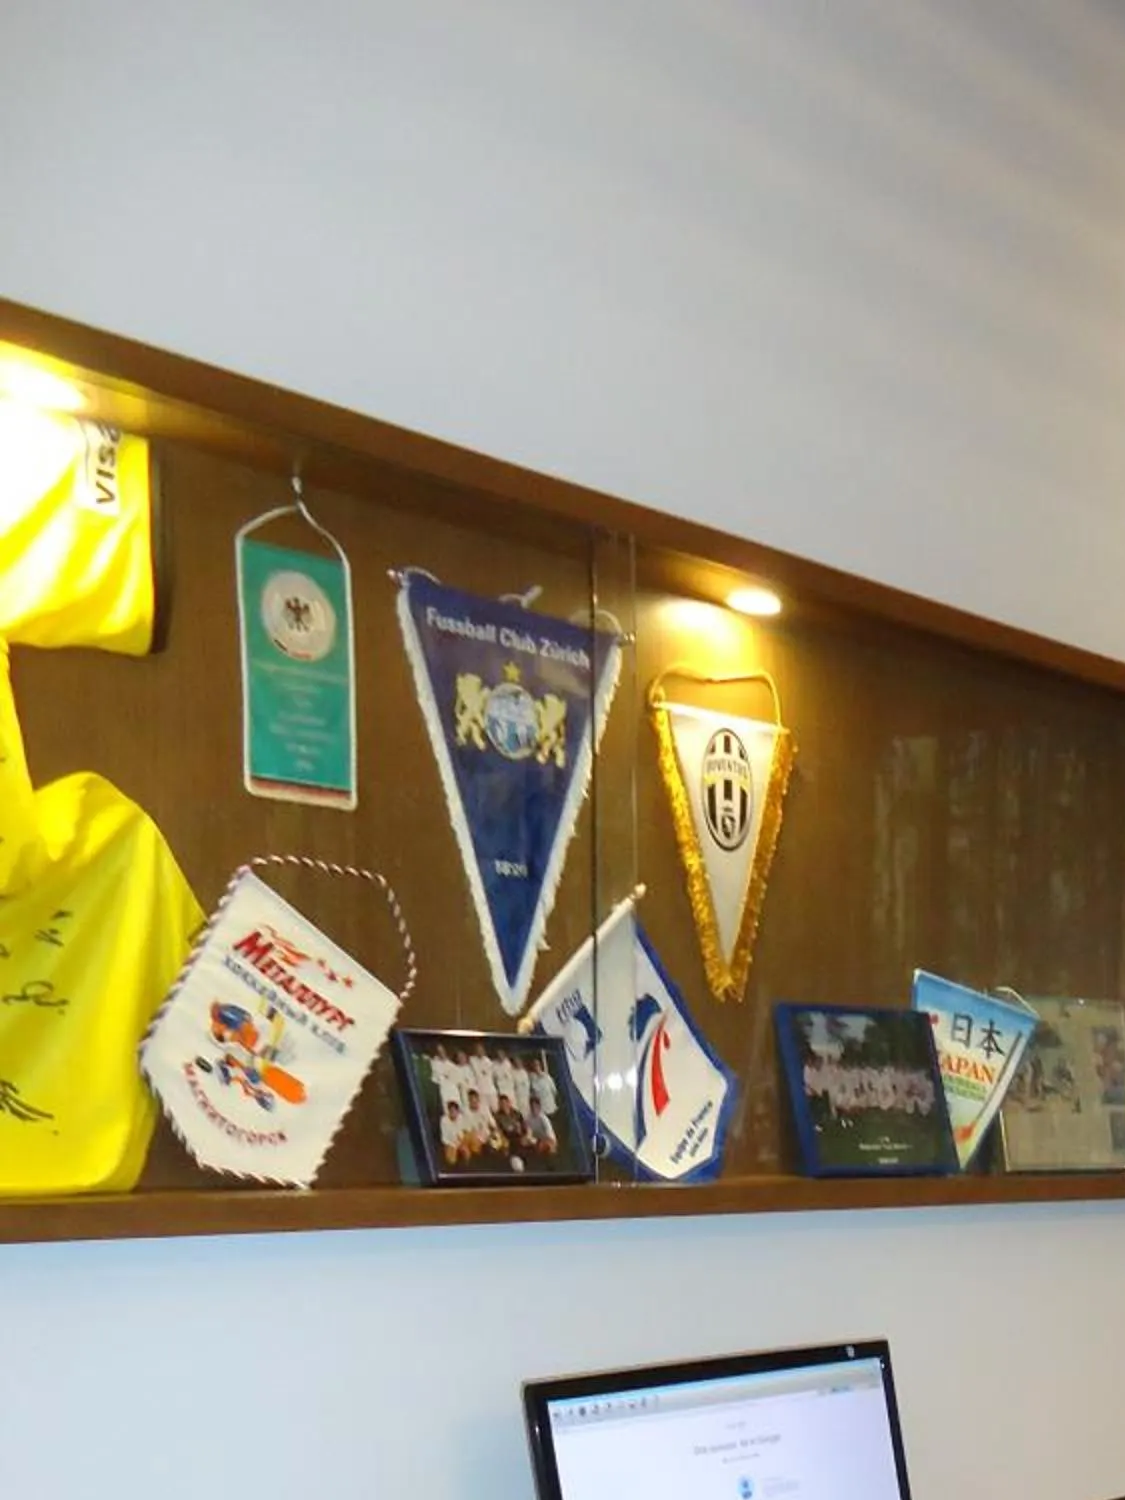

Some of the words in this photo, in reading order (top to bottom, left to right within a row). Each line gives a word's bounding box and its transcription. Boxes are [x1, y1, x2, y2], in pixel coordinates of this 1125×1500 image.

[426, 606, 496, 644] Fussball
[500, 627, 537, 653] Club
[539, 637, 590, 669] Zürich
[951, 1012, 1005, 1060] 日本
[941, 1053, 996, 1085] APAN
